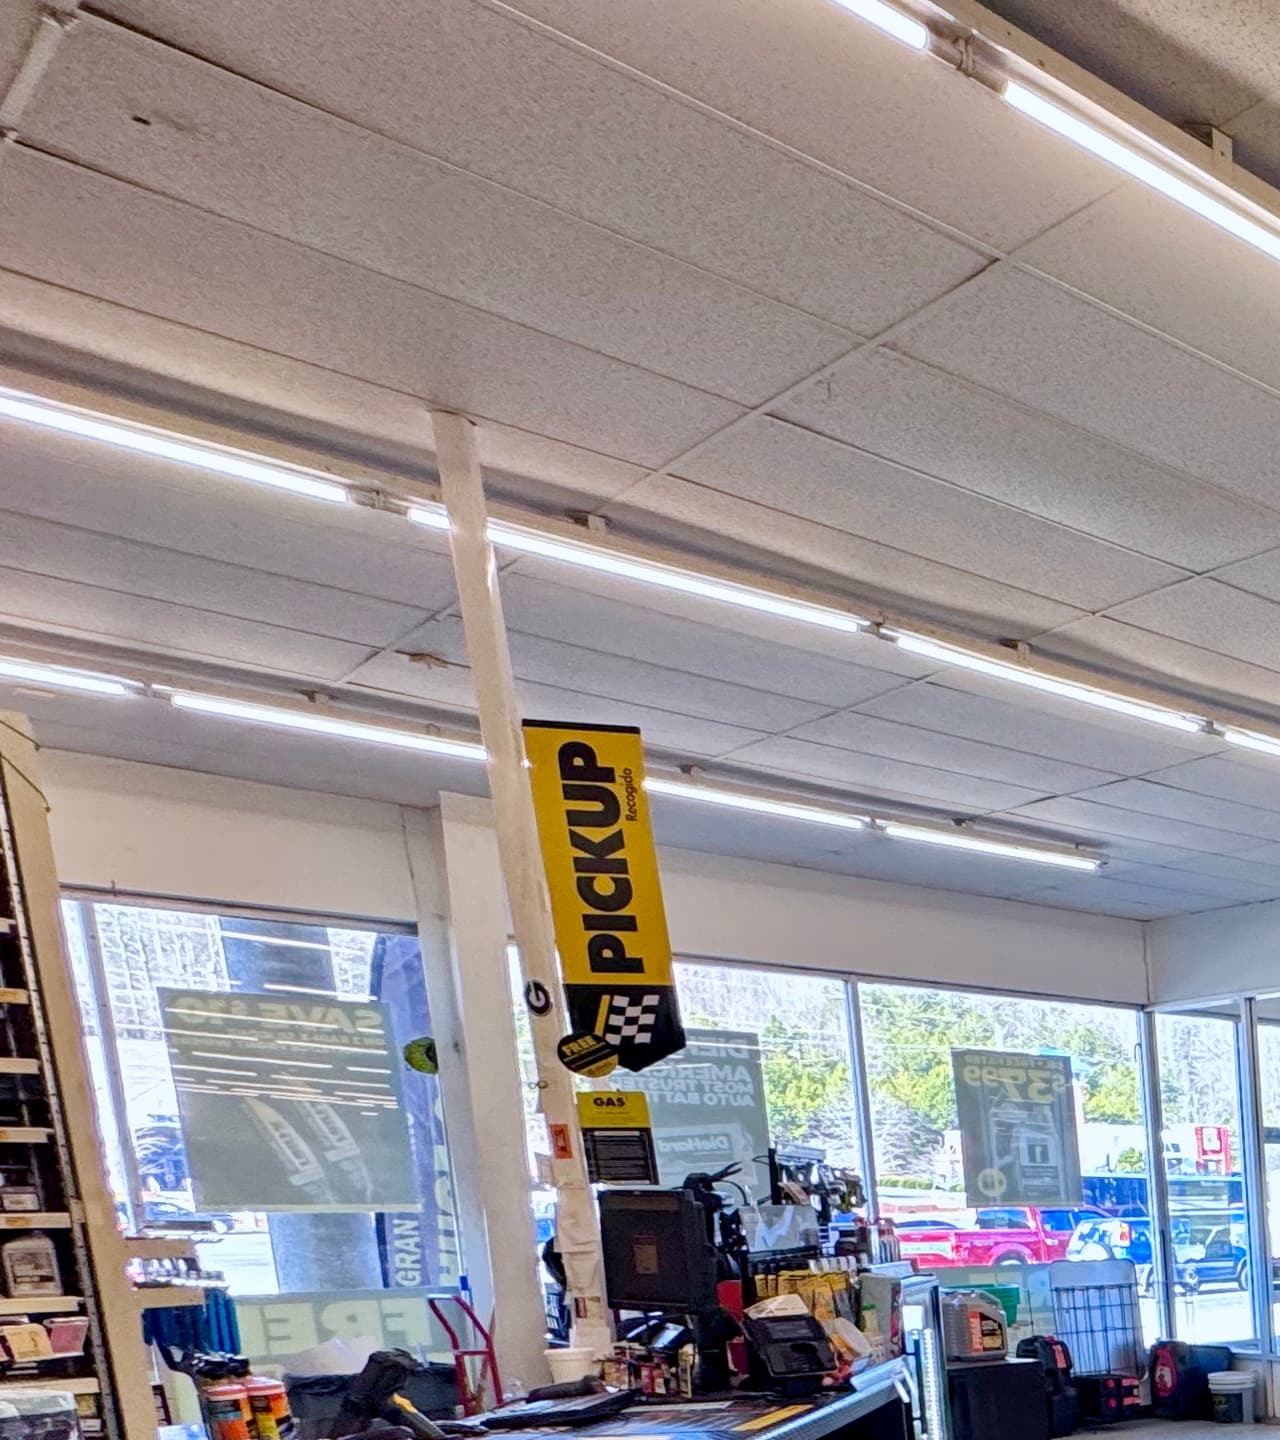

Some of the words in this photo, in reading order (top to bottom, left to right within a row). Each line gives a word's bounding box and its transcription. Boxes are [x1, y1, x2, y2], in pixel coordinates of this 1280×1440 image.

[624, 767, 639, 822] Recogido
[557, 740, 645, 975] PICKUP
[593, 1097, 626, 1107] GAS
